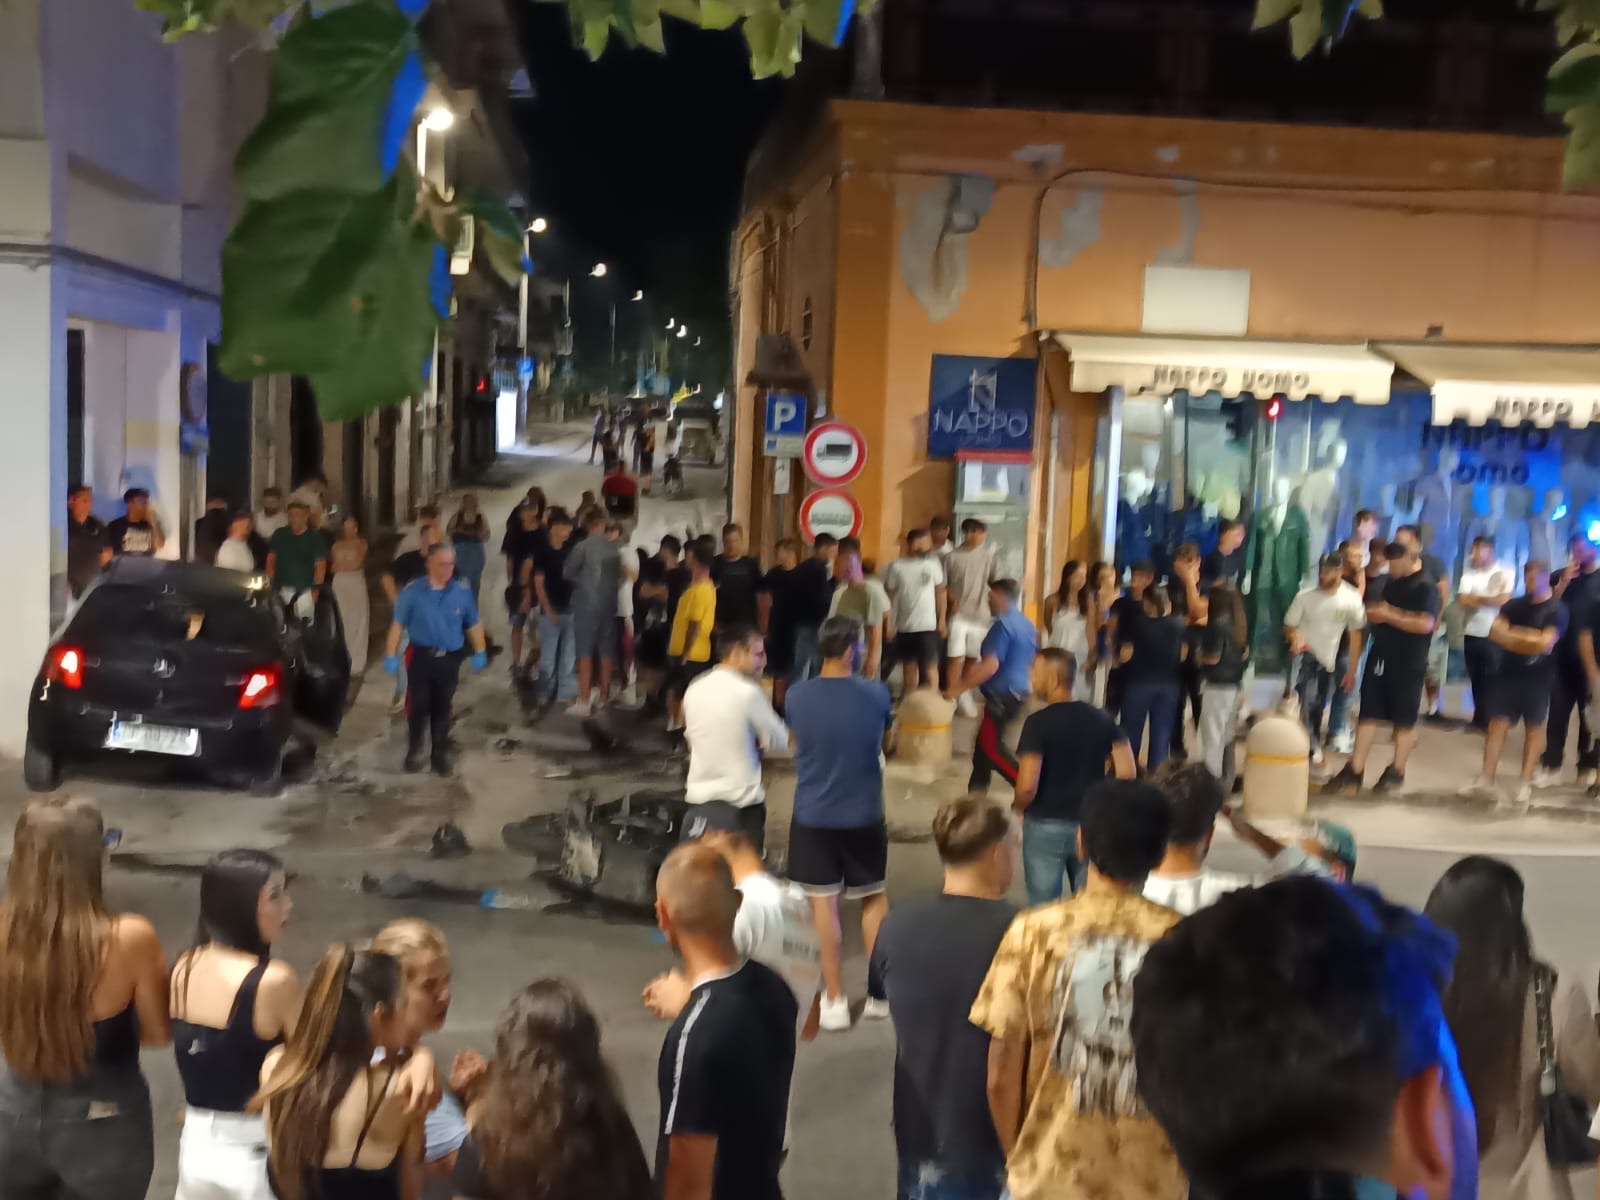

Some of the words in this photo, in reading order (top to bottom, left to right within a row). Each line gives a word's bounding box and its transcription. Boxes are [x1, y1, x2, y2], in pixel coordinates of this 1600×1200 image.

[1153, 364, 1227, 388] NAPPO
[1242, 369, 1310, 391] UOMO
[774, 401, 797, 431] P
[1495, 395, 1573, 418] NAPPO
[934, 406, 1028, 437] NAPPO
